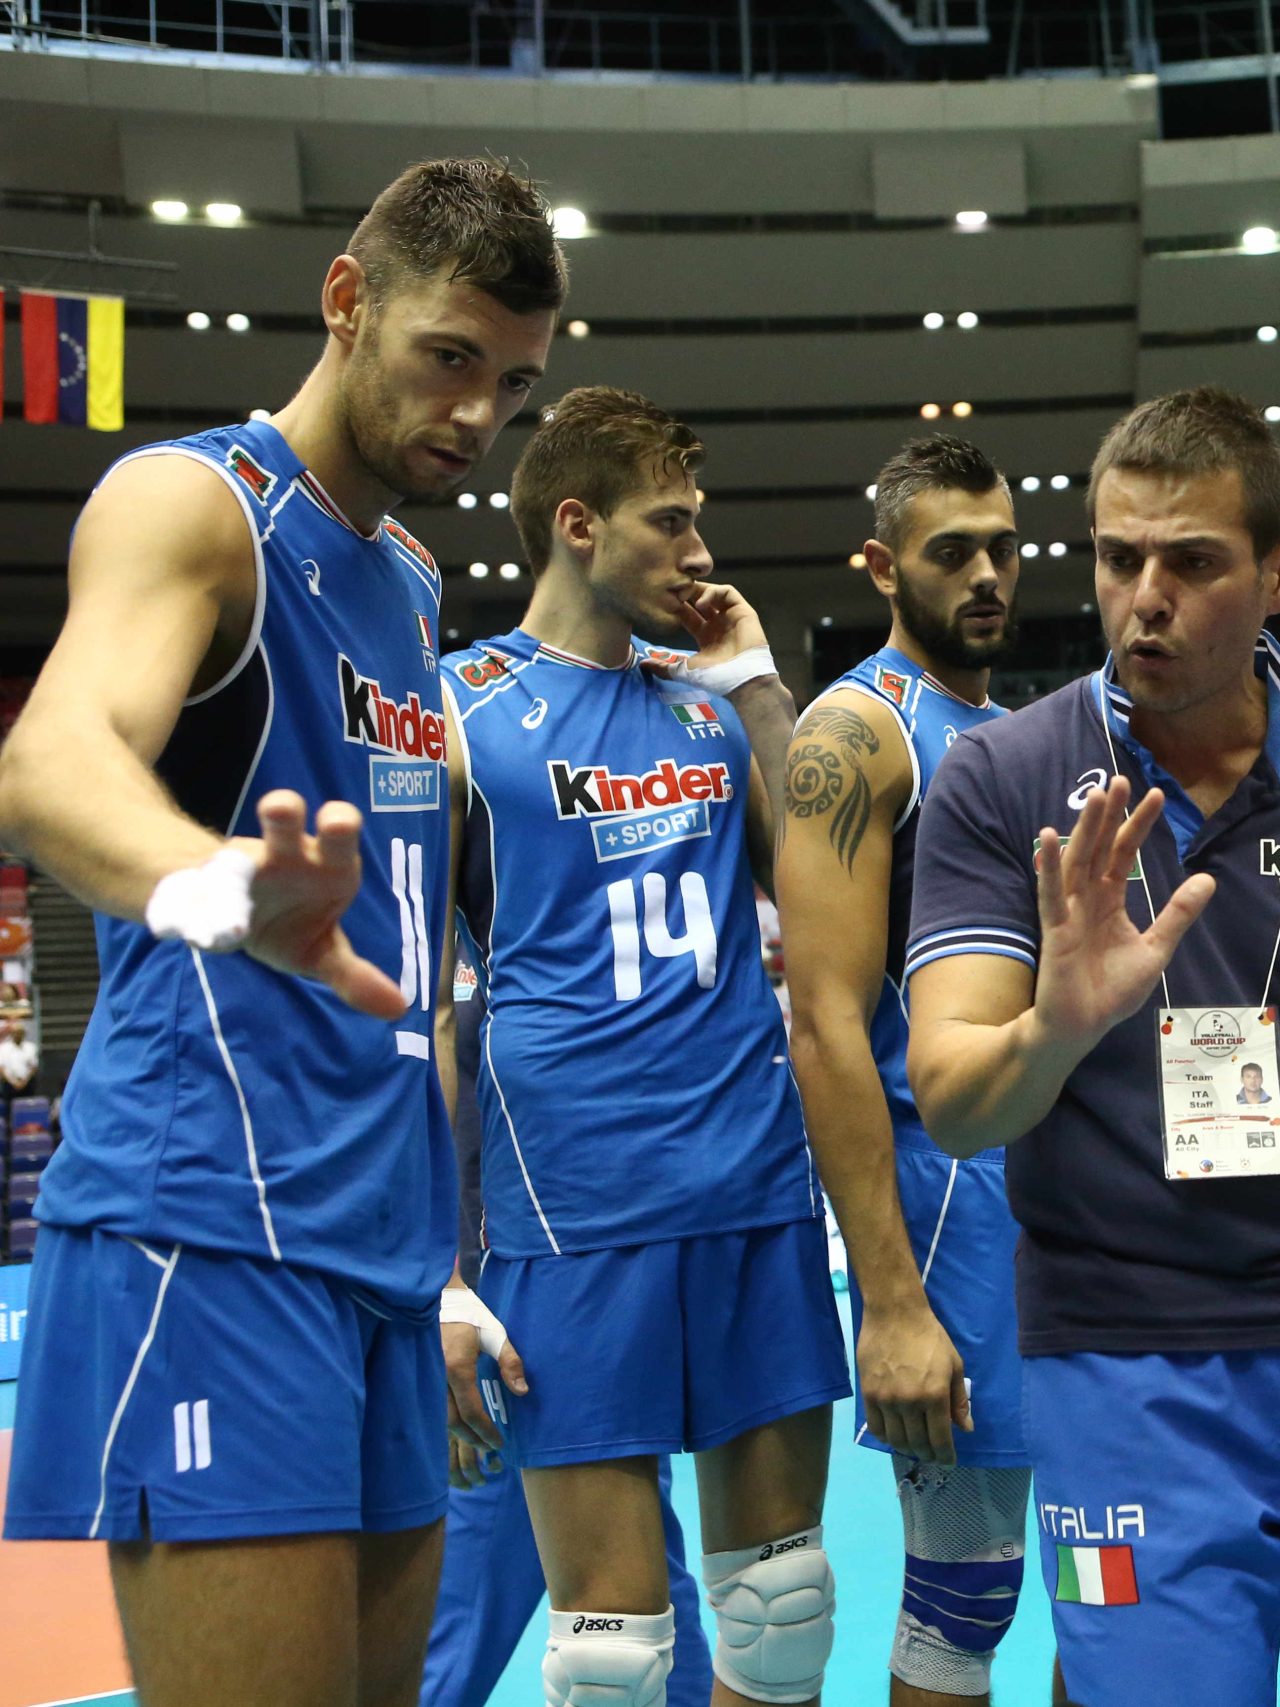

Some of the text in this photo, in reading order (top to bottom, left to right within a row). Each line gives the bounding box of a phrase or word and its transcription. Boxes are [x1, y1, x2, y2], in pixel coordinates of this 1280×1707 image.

[686, 722, 726, 740] ITA
[606, 871, 718, 1002] 14
[1190, 1037, 1246, 1046] WORLD CUP
[1189, 1101, 1213, 1109] Staff
[1175, 1134, 1199, 1145] AA
[173, 1399, 212, 1473] 11
[1040, 1503, 1145, 1540] ITALIA
[774, 1535, 808, 1554] asics
[585, 1618, 624, 1631] asics
